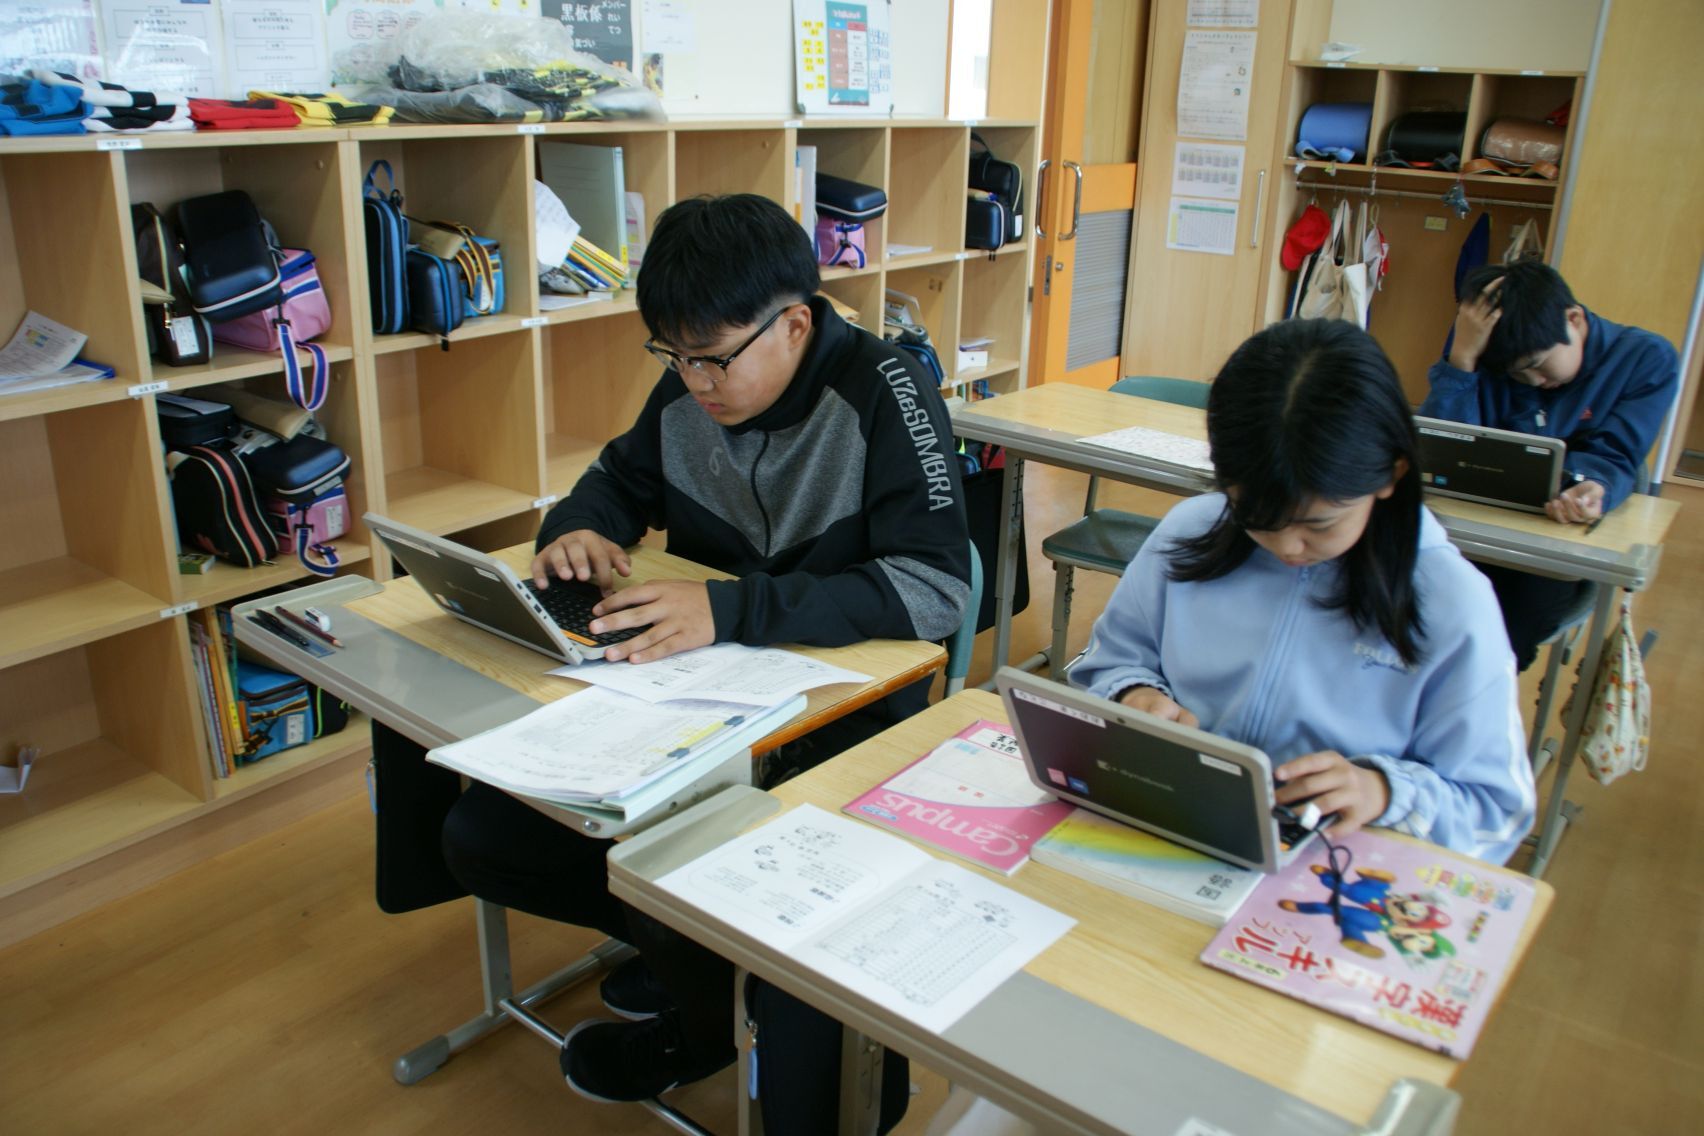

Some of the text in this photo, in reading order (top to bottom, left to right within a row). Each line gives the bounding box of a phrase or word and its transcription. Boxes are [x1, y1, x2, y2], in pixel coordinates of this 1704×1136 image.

[560, 3, 602, 22] 黒板係
[875, 793, 1019, 856] Campus
